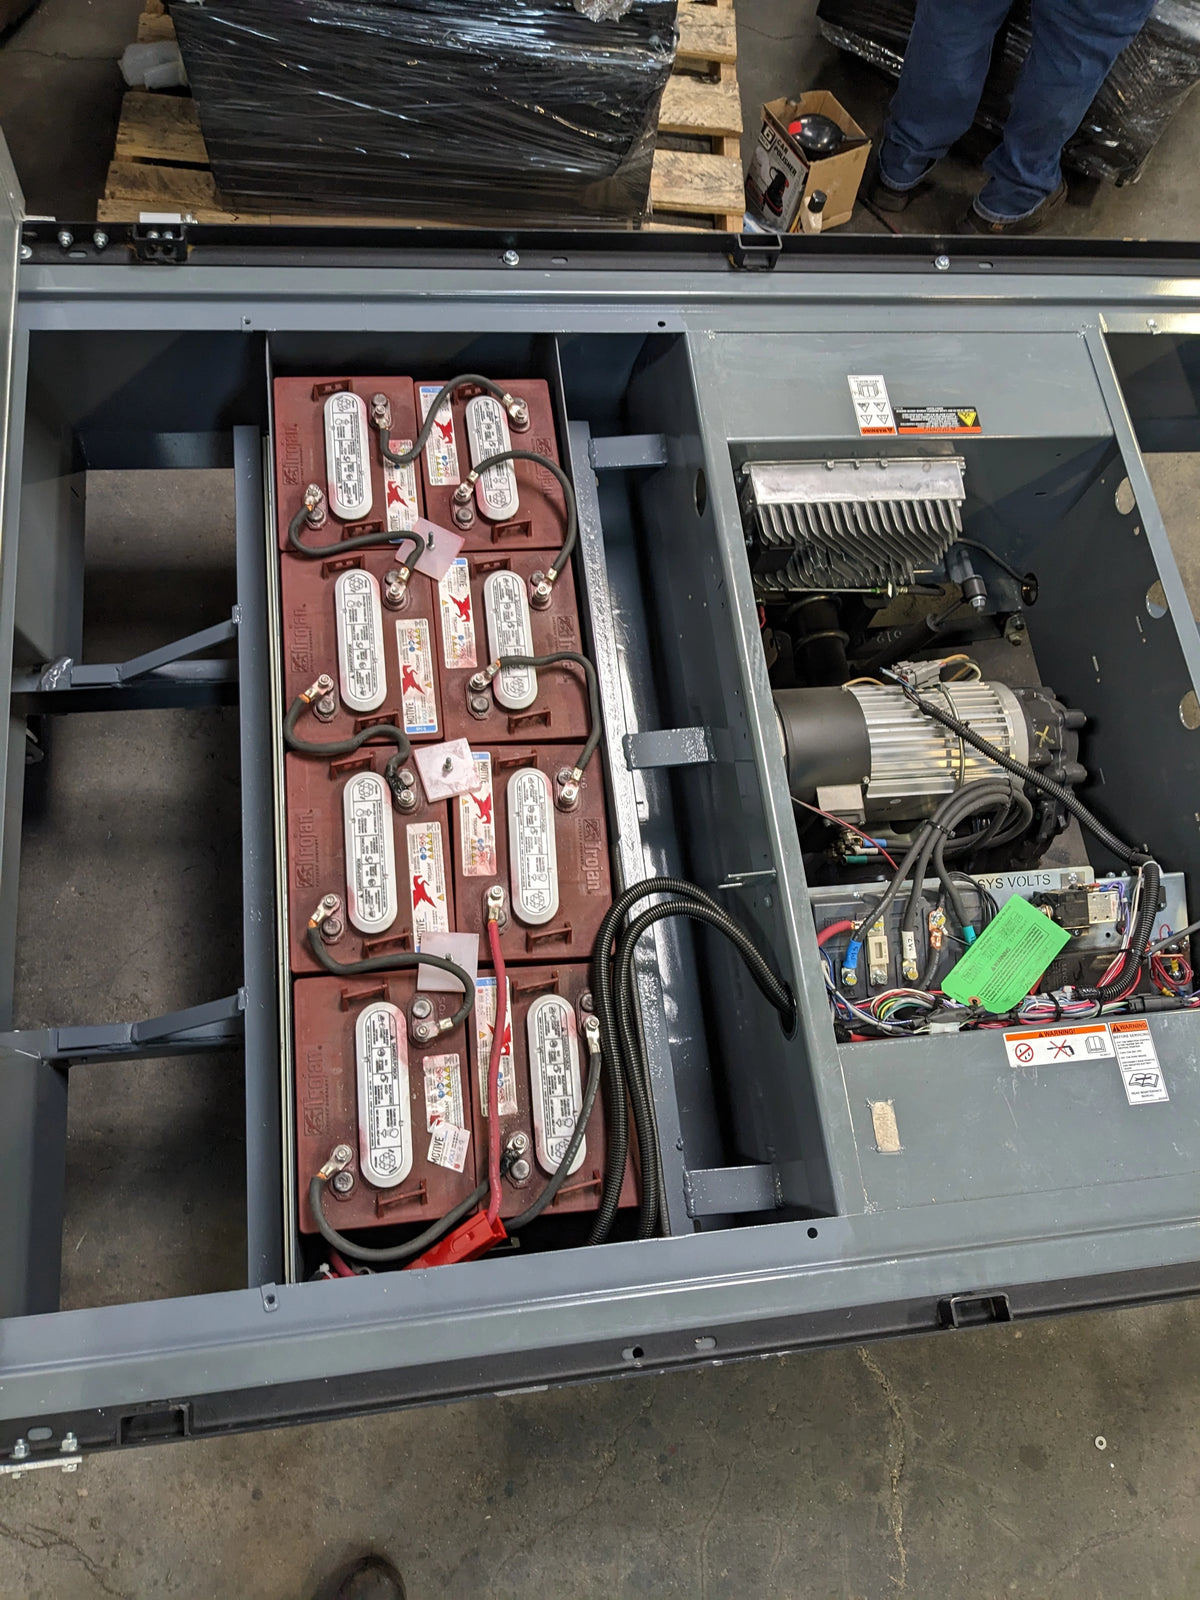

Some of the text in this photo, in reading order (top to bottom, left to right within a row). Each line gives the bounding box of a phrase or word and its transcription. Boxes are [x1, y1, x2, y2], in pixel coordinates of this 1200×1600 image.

[777, 138, 788, 155] CAR
[774, 145, 798, 176] POLISHER
[458, 566, 468, 588] MOTIVE
[405, 702, 415, 725] MOTIVE
[481, 762, 489, 784] MOTIVE
[581, 841, 604, 890] Trojan
[978, 874, 1051, 889] SYS VOLTS
[1043, 1029, 1076, 1037] WARNING!
[430, 1136, 444, 1164] MOTIVE
